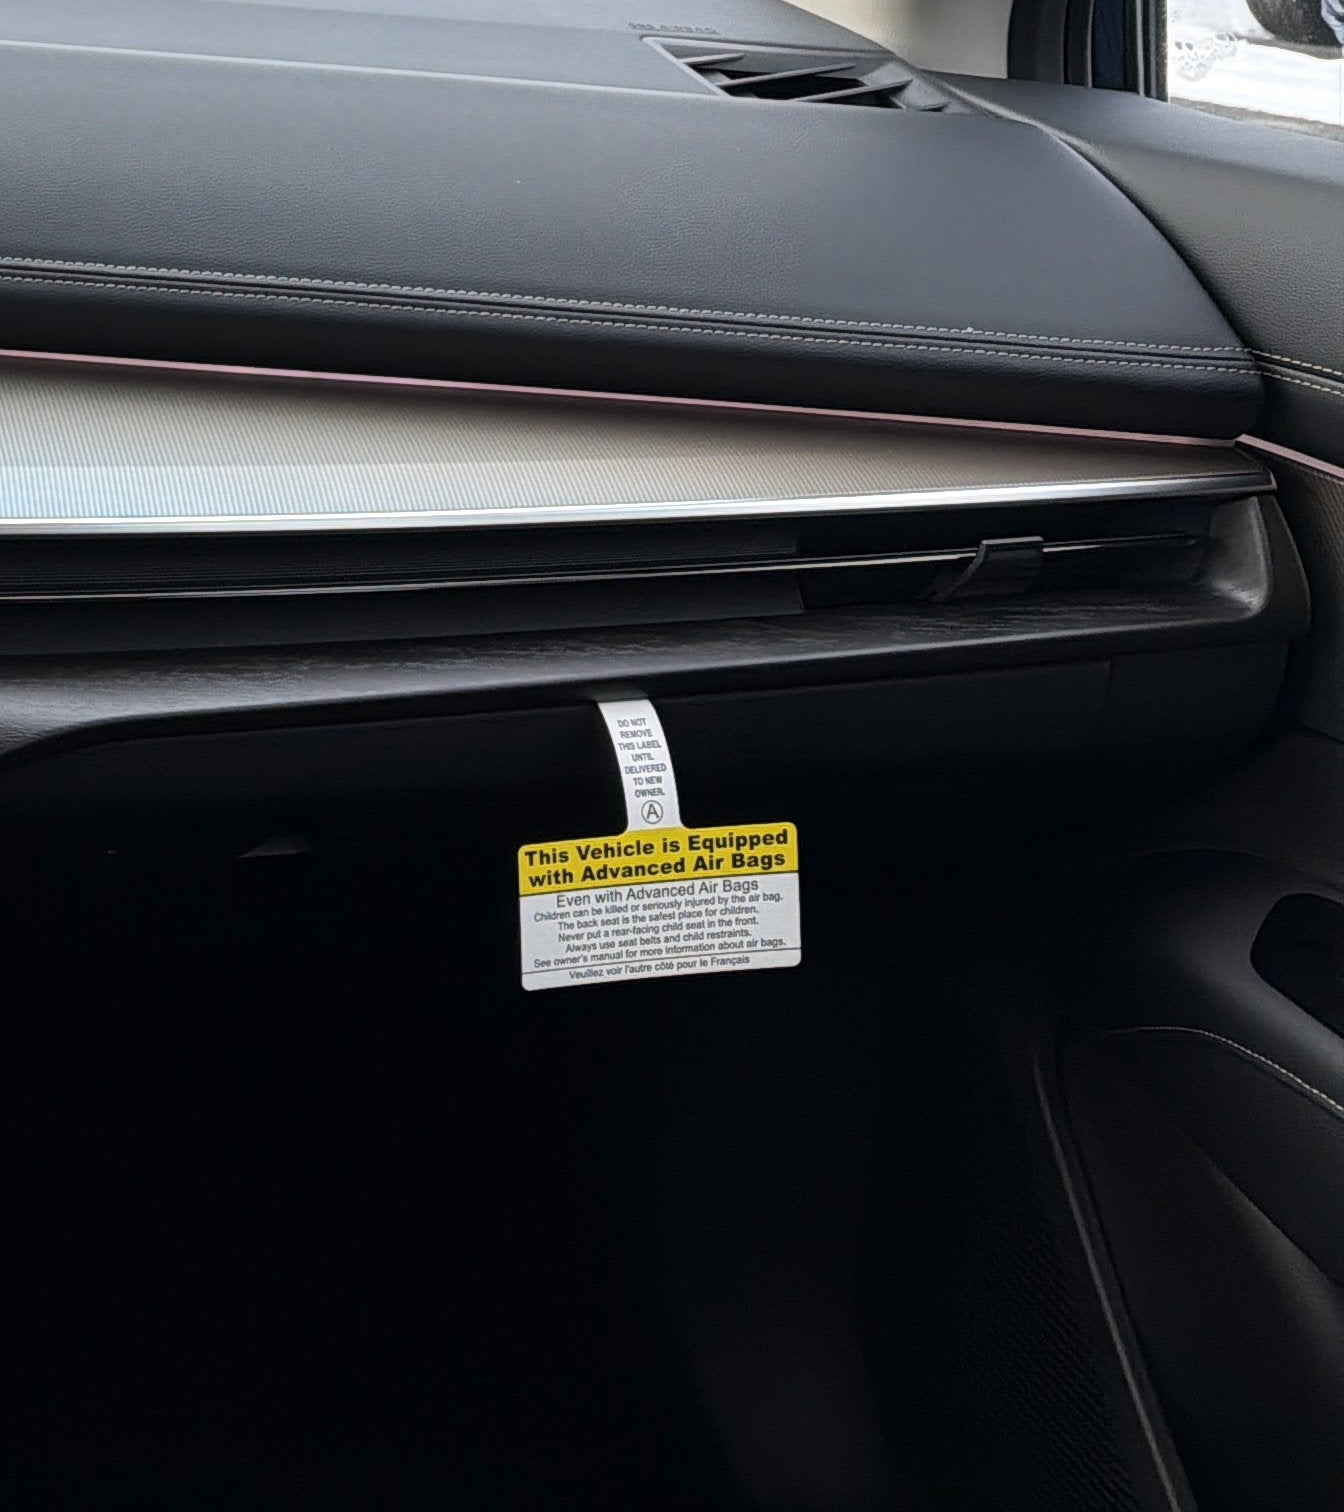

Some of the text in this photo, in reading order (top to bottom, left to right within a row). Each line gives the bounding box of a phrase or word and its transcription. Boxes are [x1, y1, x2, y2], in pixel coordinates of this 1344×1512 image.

[617, 718, 647, 728] DO NOT
[620, 729, 653, 739] REMOVE
[617, 740, 662, 751] THIS LABEL
[631, 753, 655, 762] UNTIL
[624, 763, 667, 775] DELIVERED
[632, 776, 663, 786] TO NEW
[524, 829, 788, 866] This Vehicle is Equipped
[529, 853, 786, 887] with Advanced Air Bags
[556, 879, 759, 908] Even with Advanced Air Bags
[534, 892, 784, 922] Children can be killed or seriously injured by the air bag.
[558, 905, 759, 931] The back seat is the safest place for children.
[558, 931, 585, 942] Never
[587, 930, 602, 941] put
[611, 924, 659, 937] rear-facing
[662, 921, 683, 931] child
[685, 920, 706, 930] seat
[707, 919, 716, 928] in
[717, 918, 732, 927] the
[734, 916, 759, 926] front.
[565, 928, 752, 954] Always use seat belts and child restraints.
[534, 937, 786, 968] See owner's manual for more information about air bags.
[568, 969, 604, 980] Veuillez
[606, 966, 623, 976] voir
[624, 963, 652, 974] l'autre
[676, 961, 697, 971] pour
[699, 958, 708, 967] le
[710, 955, 750, 967] Français
